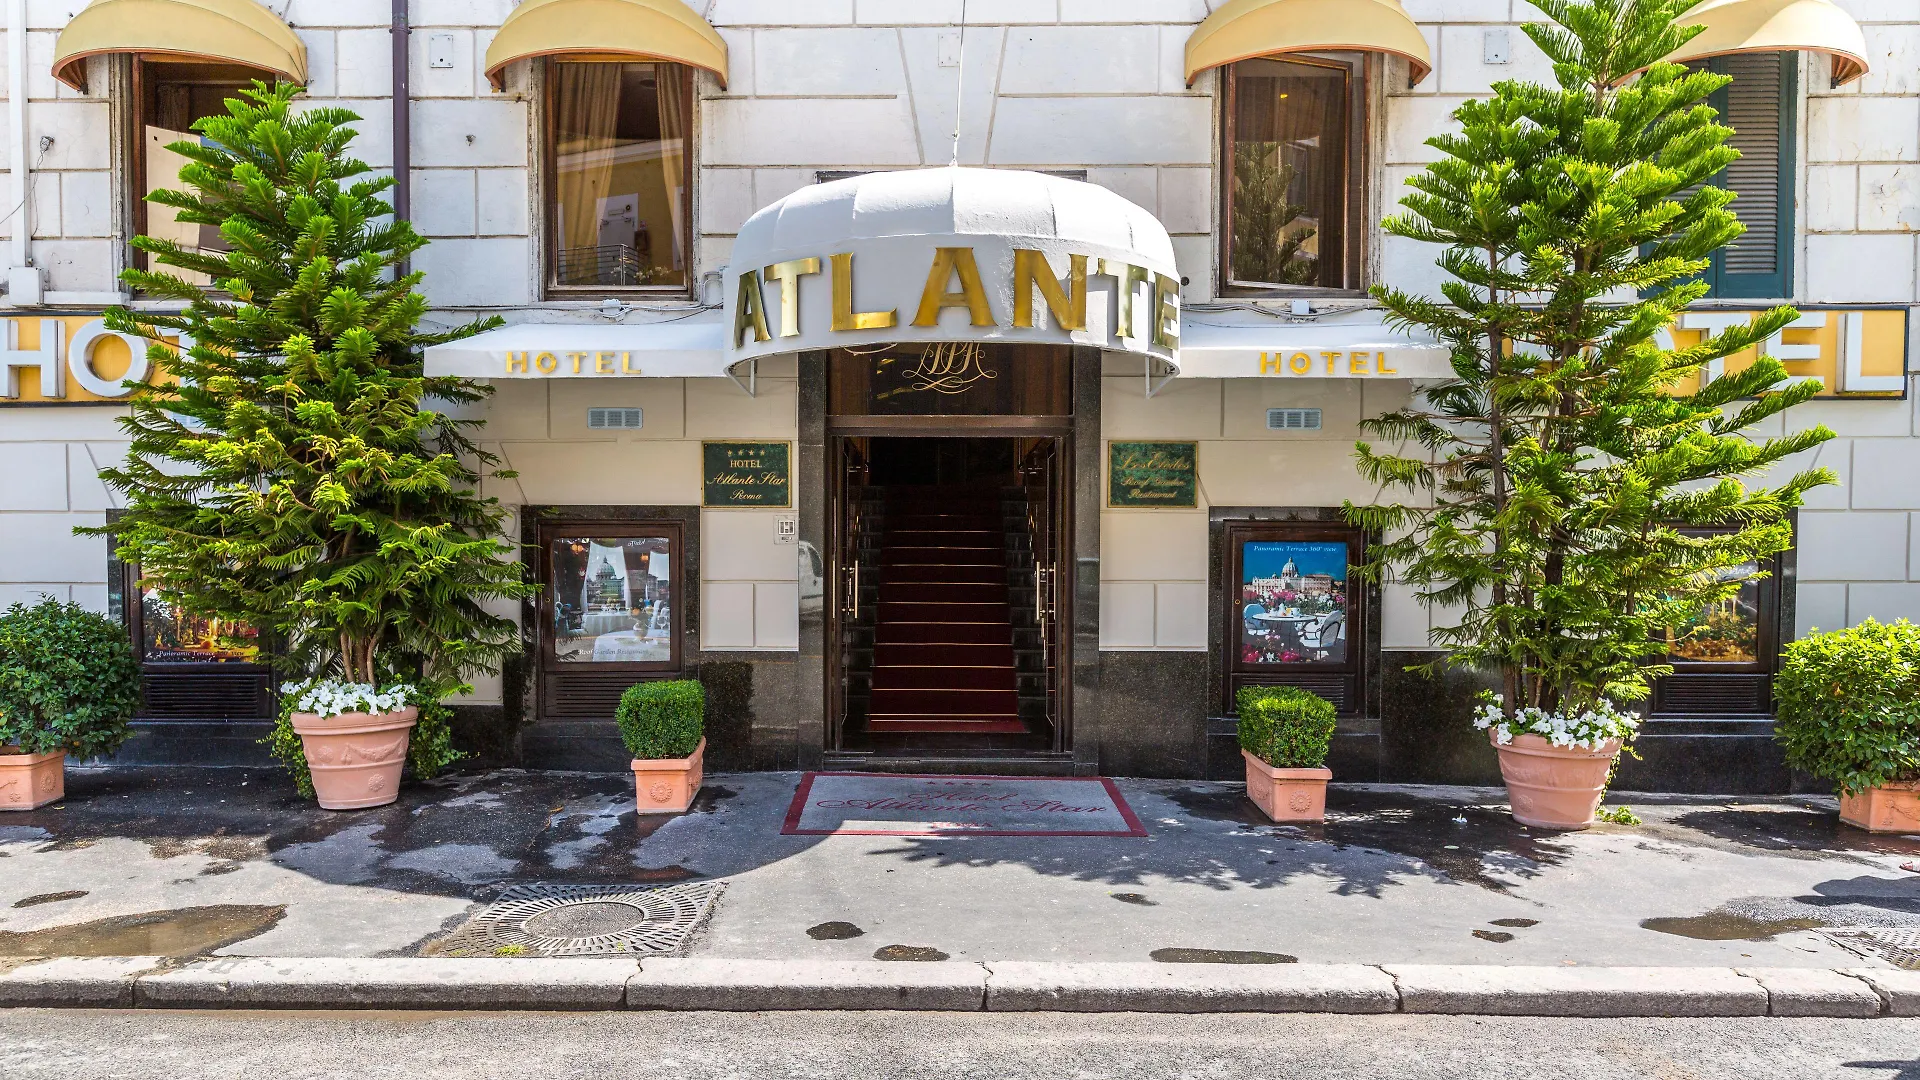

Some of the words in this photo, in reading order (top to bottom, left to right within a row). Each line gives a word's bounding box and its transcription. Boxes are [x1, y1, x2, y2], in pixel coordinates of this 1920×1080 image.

[734, 247, 1180, 350] ATLANTE
[505, 351, 642, 374] HOTEL
[1259, 351, 1397, 374] HOTEL
[730, 460, 763, 468] HOTEL
[706, 472, 755, 485] Atlante
[757, 472, 787, 485] Star
[730, 489, 762, 500] Roma
[816, 797, 988, 812] Atlante
[1001, 799, 1107, 813] Star
